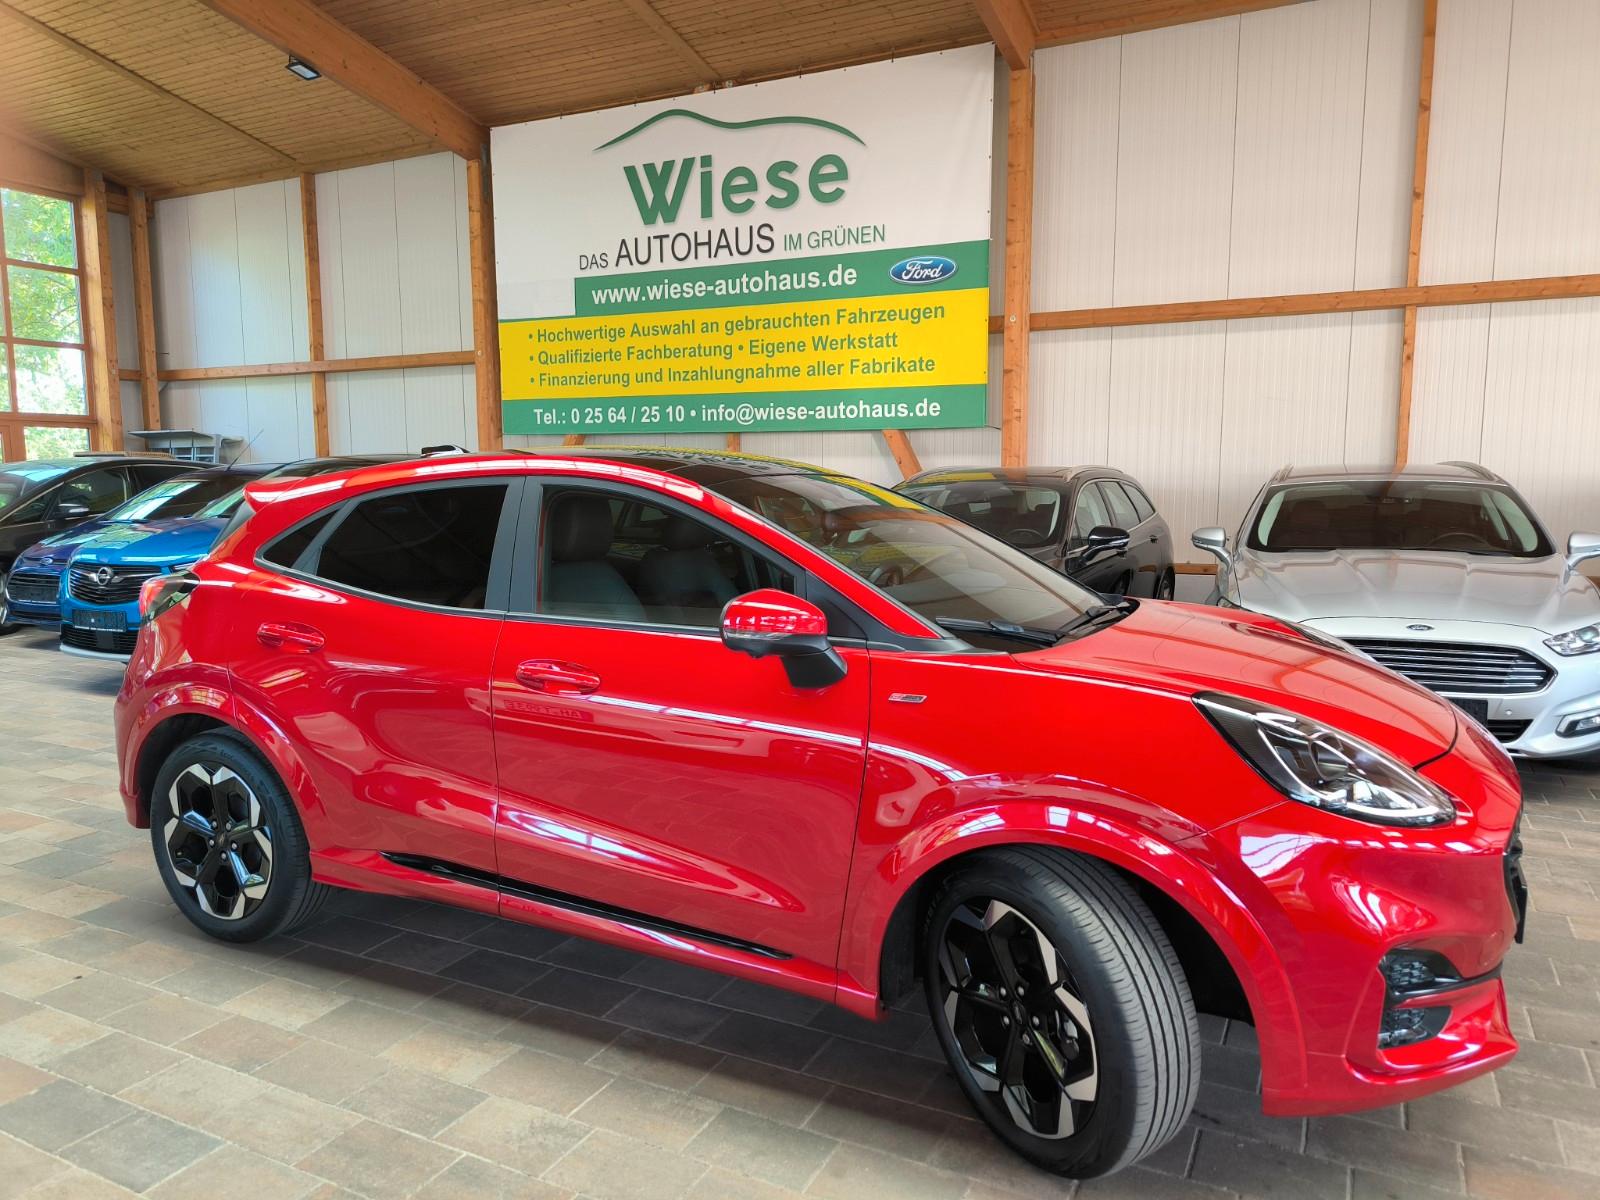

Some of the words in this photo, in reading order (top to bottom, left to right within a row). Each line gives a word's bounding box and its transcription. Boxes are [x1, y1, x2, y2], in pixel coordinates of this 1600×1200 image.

[623, 153, 849, 225] Wiese
[579, 253, 609, 270] DAS
[615, 223, 775, 267] AUTOHAUS
[784, 233, 802, 251] IM
[807, 223, 886, 249] GRÜNEN
[592, 263, 857, 304] www.wiese-autohaus.de
[902, 260, 943, 280] Ford
[537, 324, 625, 343] Hochwertige
[630, 319, 695, 337] Auswahl
[700, 319, 719, 333] an
[724, 311, 830, 335] gebrauchten
[836, 305, 945, 325] Fahrzeugen
[538, 348, 622, 366] Qualifizierte
[627, 343, 733, 361] Fachberatung
[750, 338, 806, 357] Eigene
[812, 331, 898, 351] Werkstatt
[539, 370, 630, 387] Finanzierung
[635, 368, 663, 383] und
[668, 361, 800, 383] Inzahlungnahme
[806, 360, 844, 377] aller
[850, 356, 935, 374] Fabrikate
[534, 408, 566, 424] Tel.:
[571, 408, 580, 424] 0
[584, 407, 602, 424] 25
[608, 406, 627, 423] 64
[631, 406, 636, 423] /
[641, 406, 660, 423] 25
[666, 405, 685, 422] 10
[701, 398, 941, 425] info@wiese-autohaus.de
